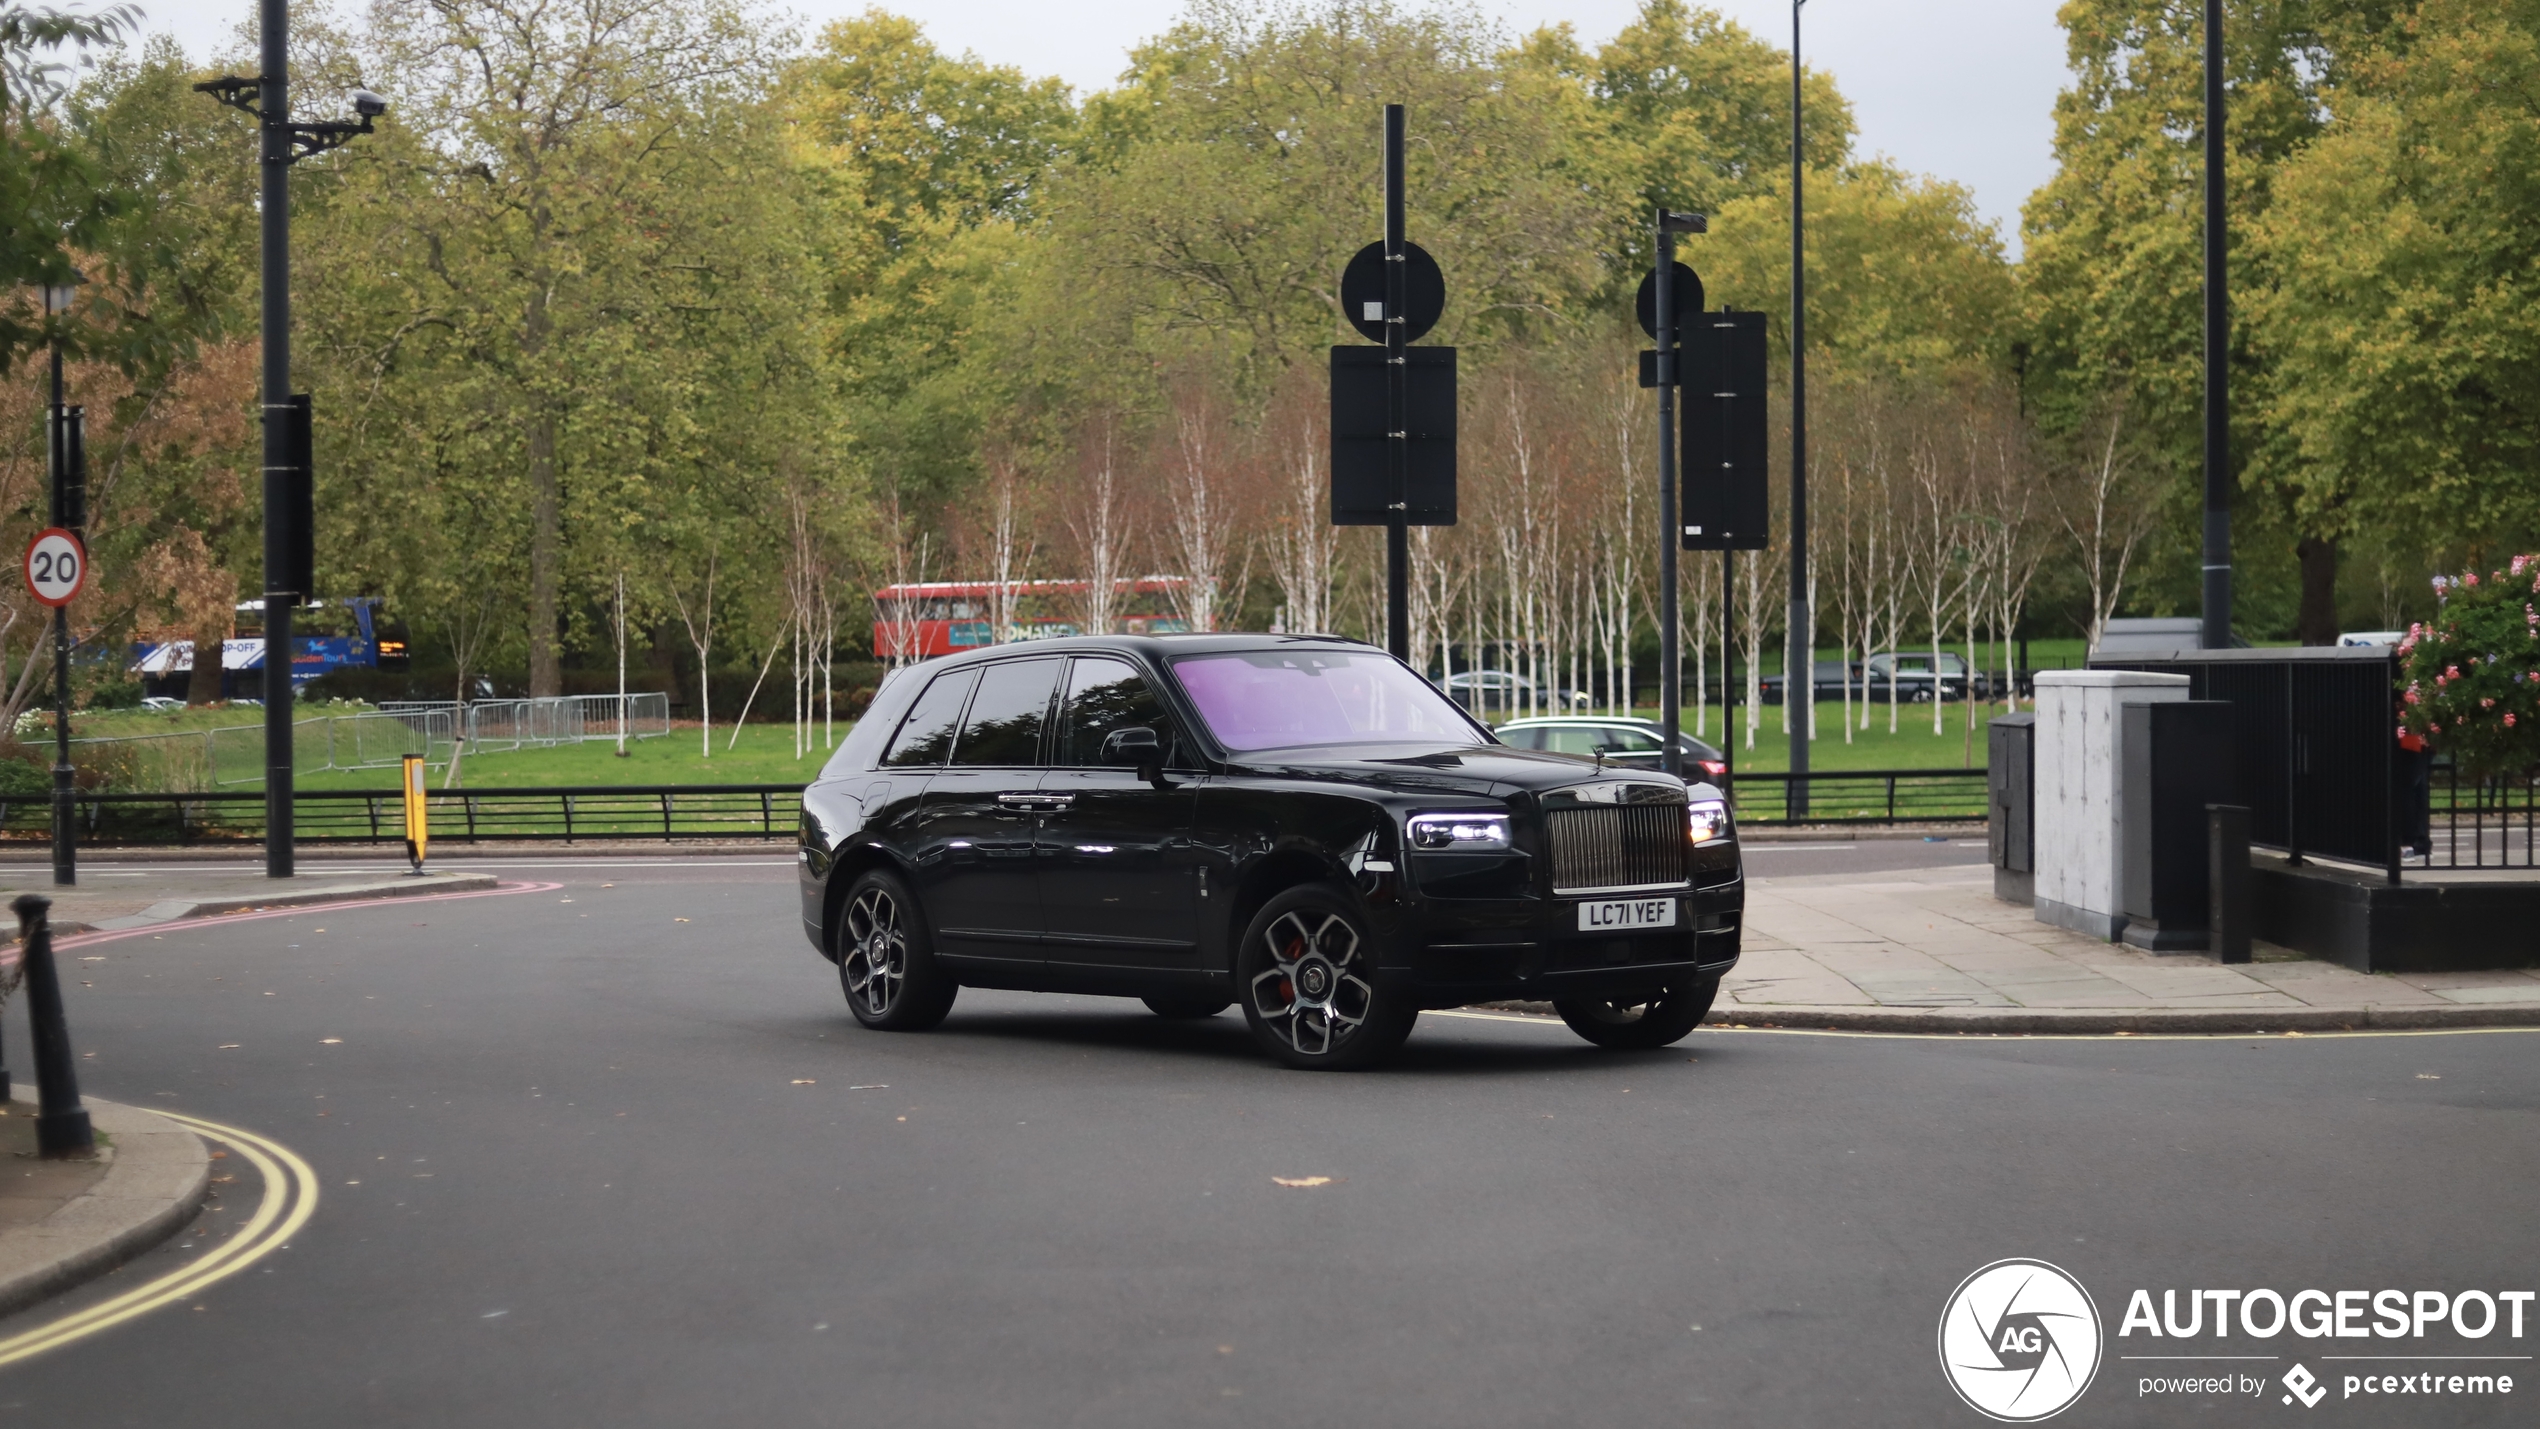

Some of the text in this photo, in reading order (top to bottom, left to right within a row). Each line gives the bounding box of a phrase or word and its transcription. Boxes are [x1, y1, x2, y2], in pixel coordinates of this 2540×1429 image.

[34, 551, 76, 583] 20
[1590, 901, 1667, 926] LC71 YEF
